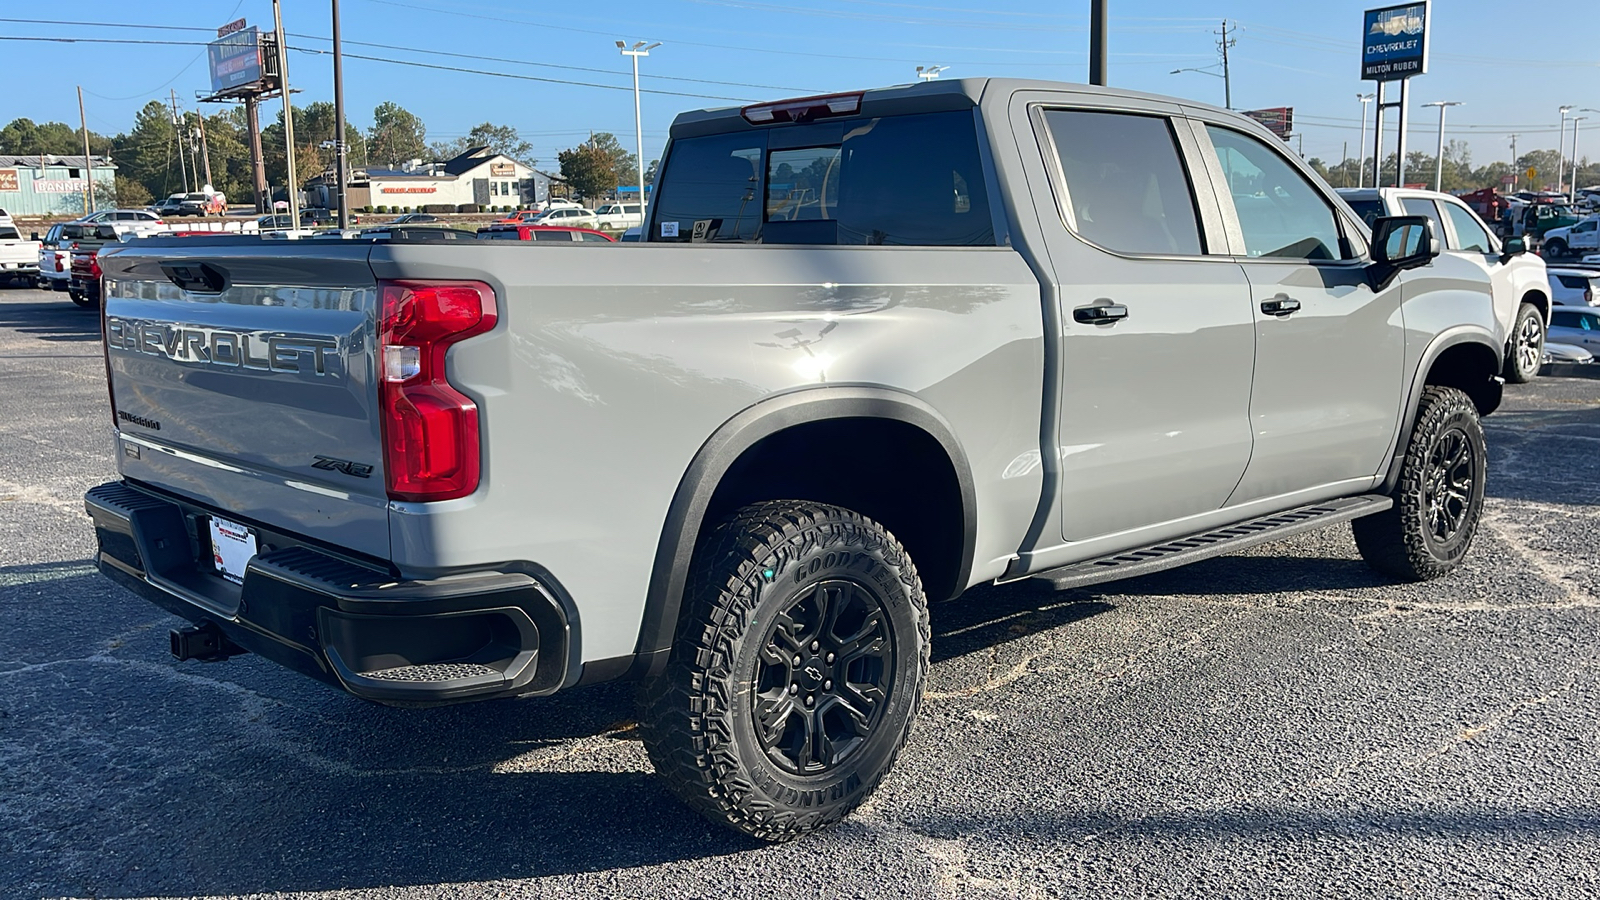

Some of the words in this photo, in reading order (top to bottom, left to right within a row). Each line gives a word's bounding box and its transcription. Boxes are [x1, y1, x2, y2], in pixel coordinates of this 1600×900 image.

[1366, 40, 1418, 54] CHEVROLET
[1366, 64, 1391, 74] MILTON
[1393, 61, 1418, 71] RUBEN
[107, 319, 338, 376] CHEVROLET
[311, 454, 374, 479] ZR2
[751, 760, 862, 808] WRANGLER
